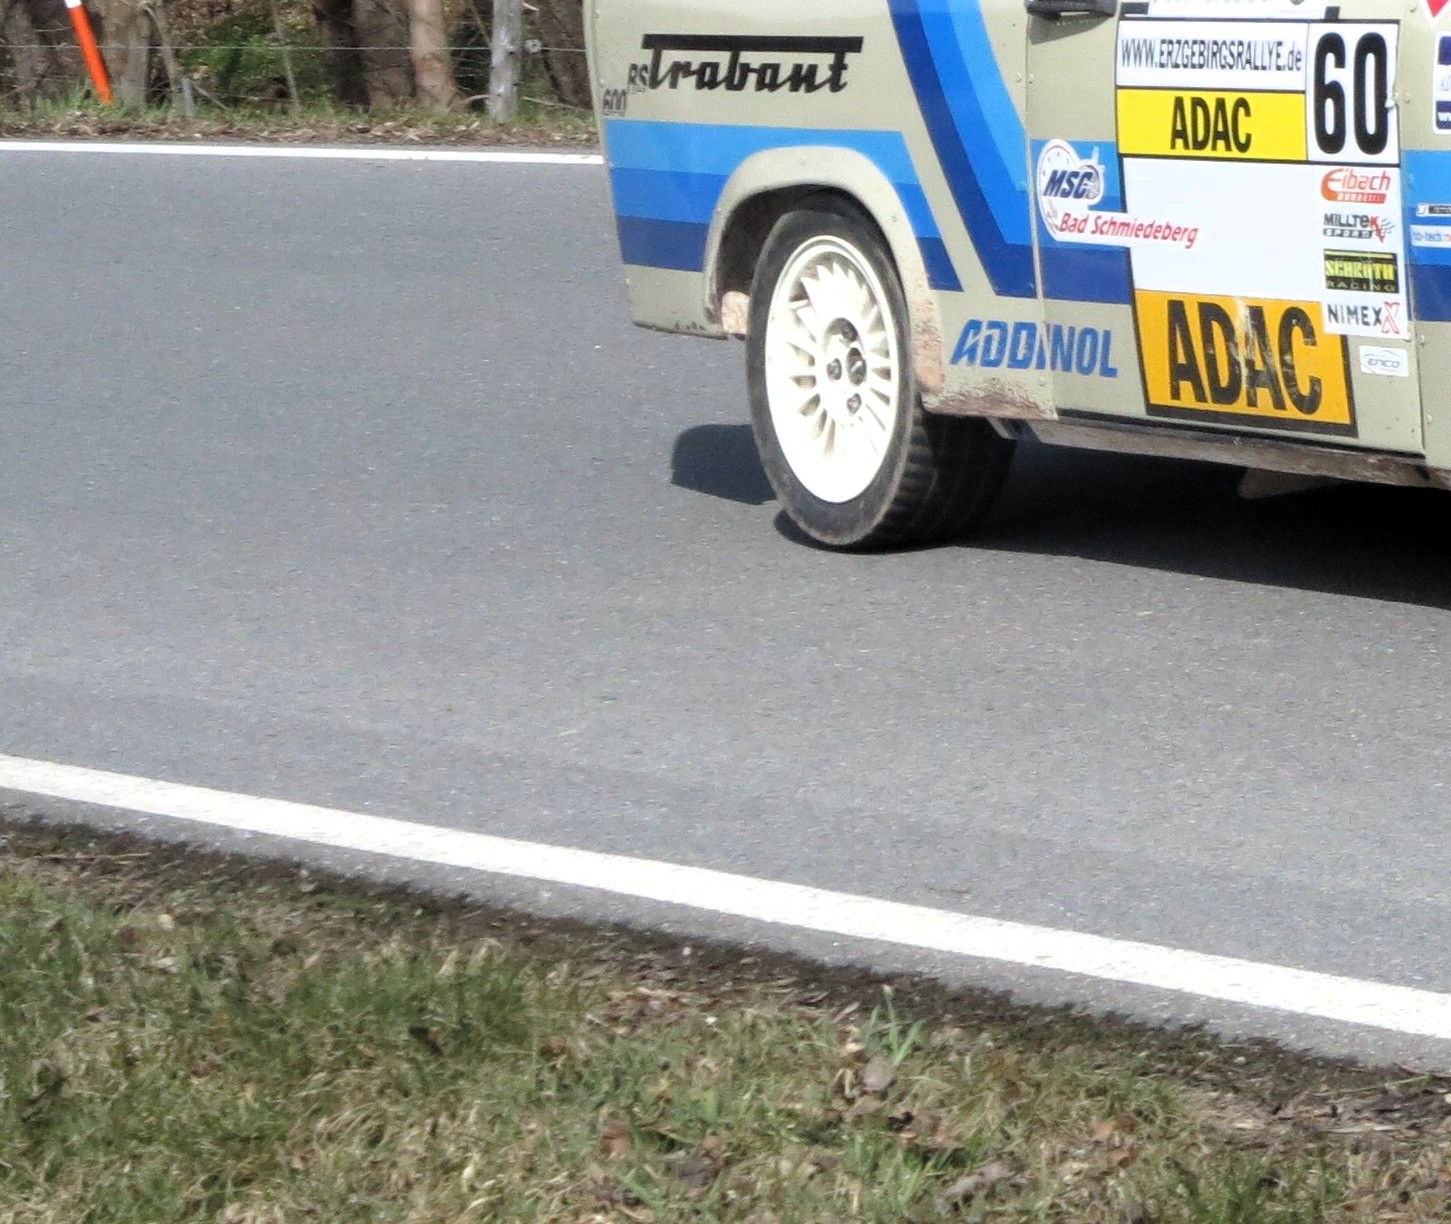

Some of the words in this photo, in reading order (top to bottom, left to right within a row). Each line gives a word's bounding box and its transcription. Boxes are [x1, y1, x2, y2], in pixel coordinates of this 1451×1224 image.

[641, 34, 864, 92] Trabant
[1313, 32, 1388, 155] 60
[1170, 95, 1252, 153] ADAC
[1043, 169, 1092, 199] MSC
[1320, 168, 1391, 204] Eibach
[1059, 211, 1090, 233] Bad
[1091, 215, 1198, 250] Schmiedeberg
[1327, 280, 1396, 292] RACING
[950, 319, 1118, 378] ADDINOL
[1167, 300, 1322, 415] ADAC
